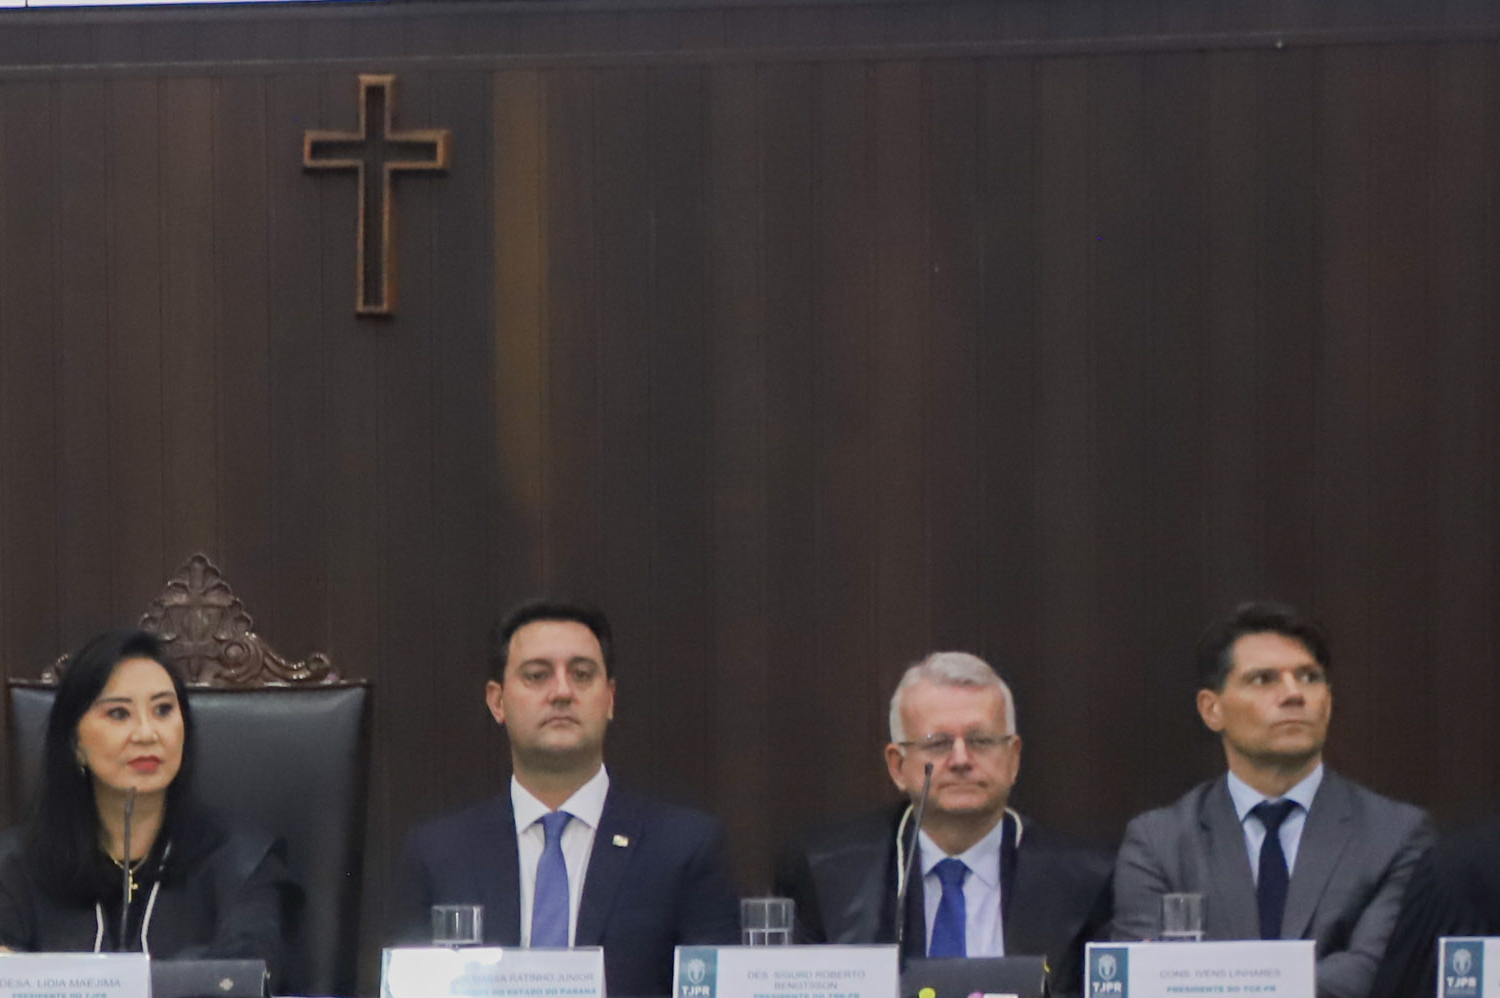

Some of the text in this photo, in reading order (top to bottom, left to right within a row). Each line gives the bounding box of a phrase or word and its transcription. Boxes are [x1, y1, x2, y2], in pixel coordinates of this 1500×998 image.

[815, 969, 866, 980] ROBERTO
[68, 978, 122, 988] MAEJIMA
[1092, 981, 1122, 992] TJPR
[1446, 976, 1477, 988] TJPR
[507, 987, 543, 996] ESTADO
[681, 985, 710, 996] TJPR
[1166, 985, 1224, 993] PRESIDENTE
[1227, 985, 1240, 993] DO
